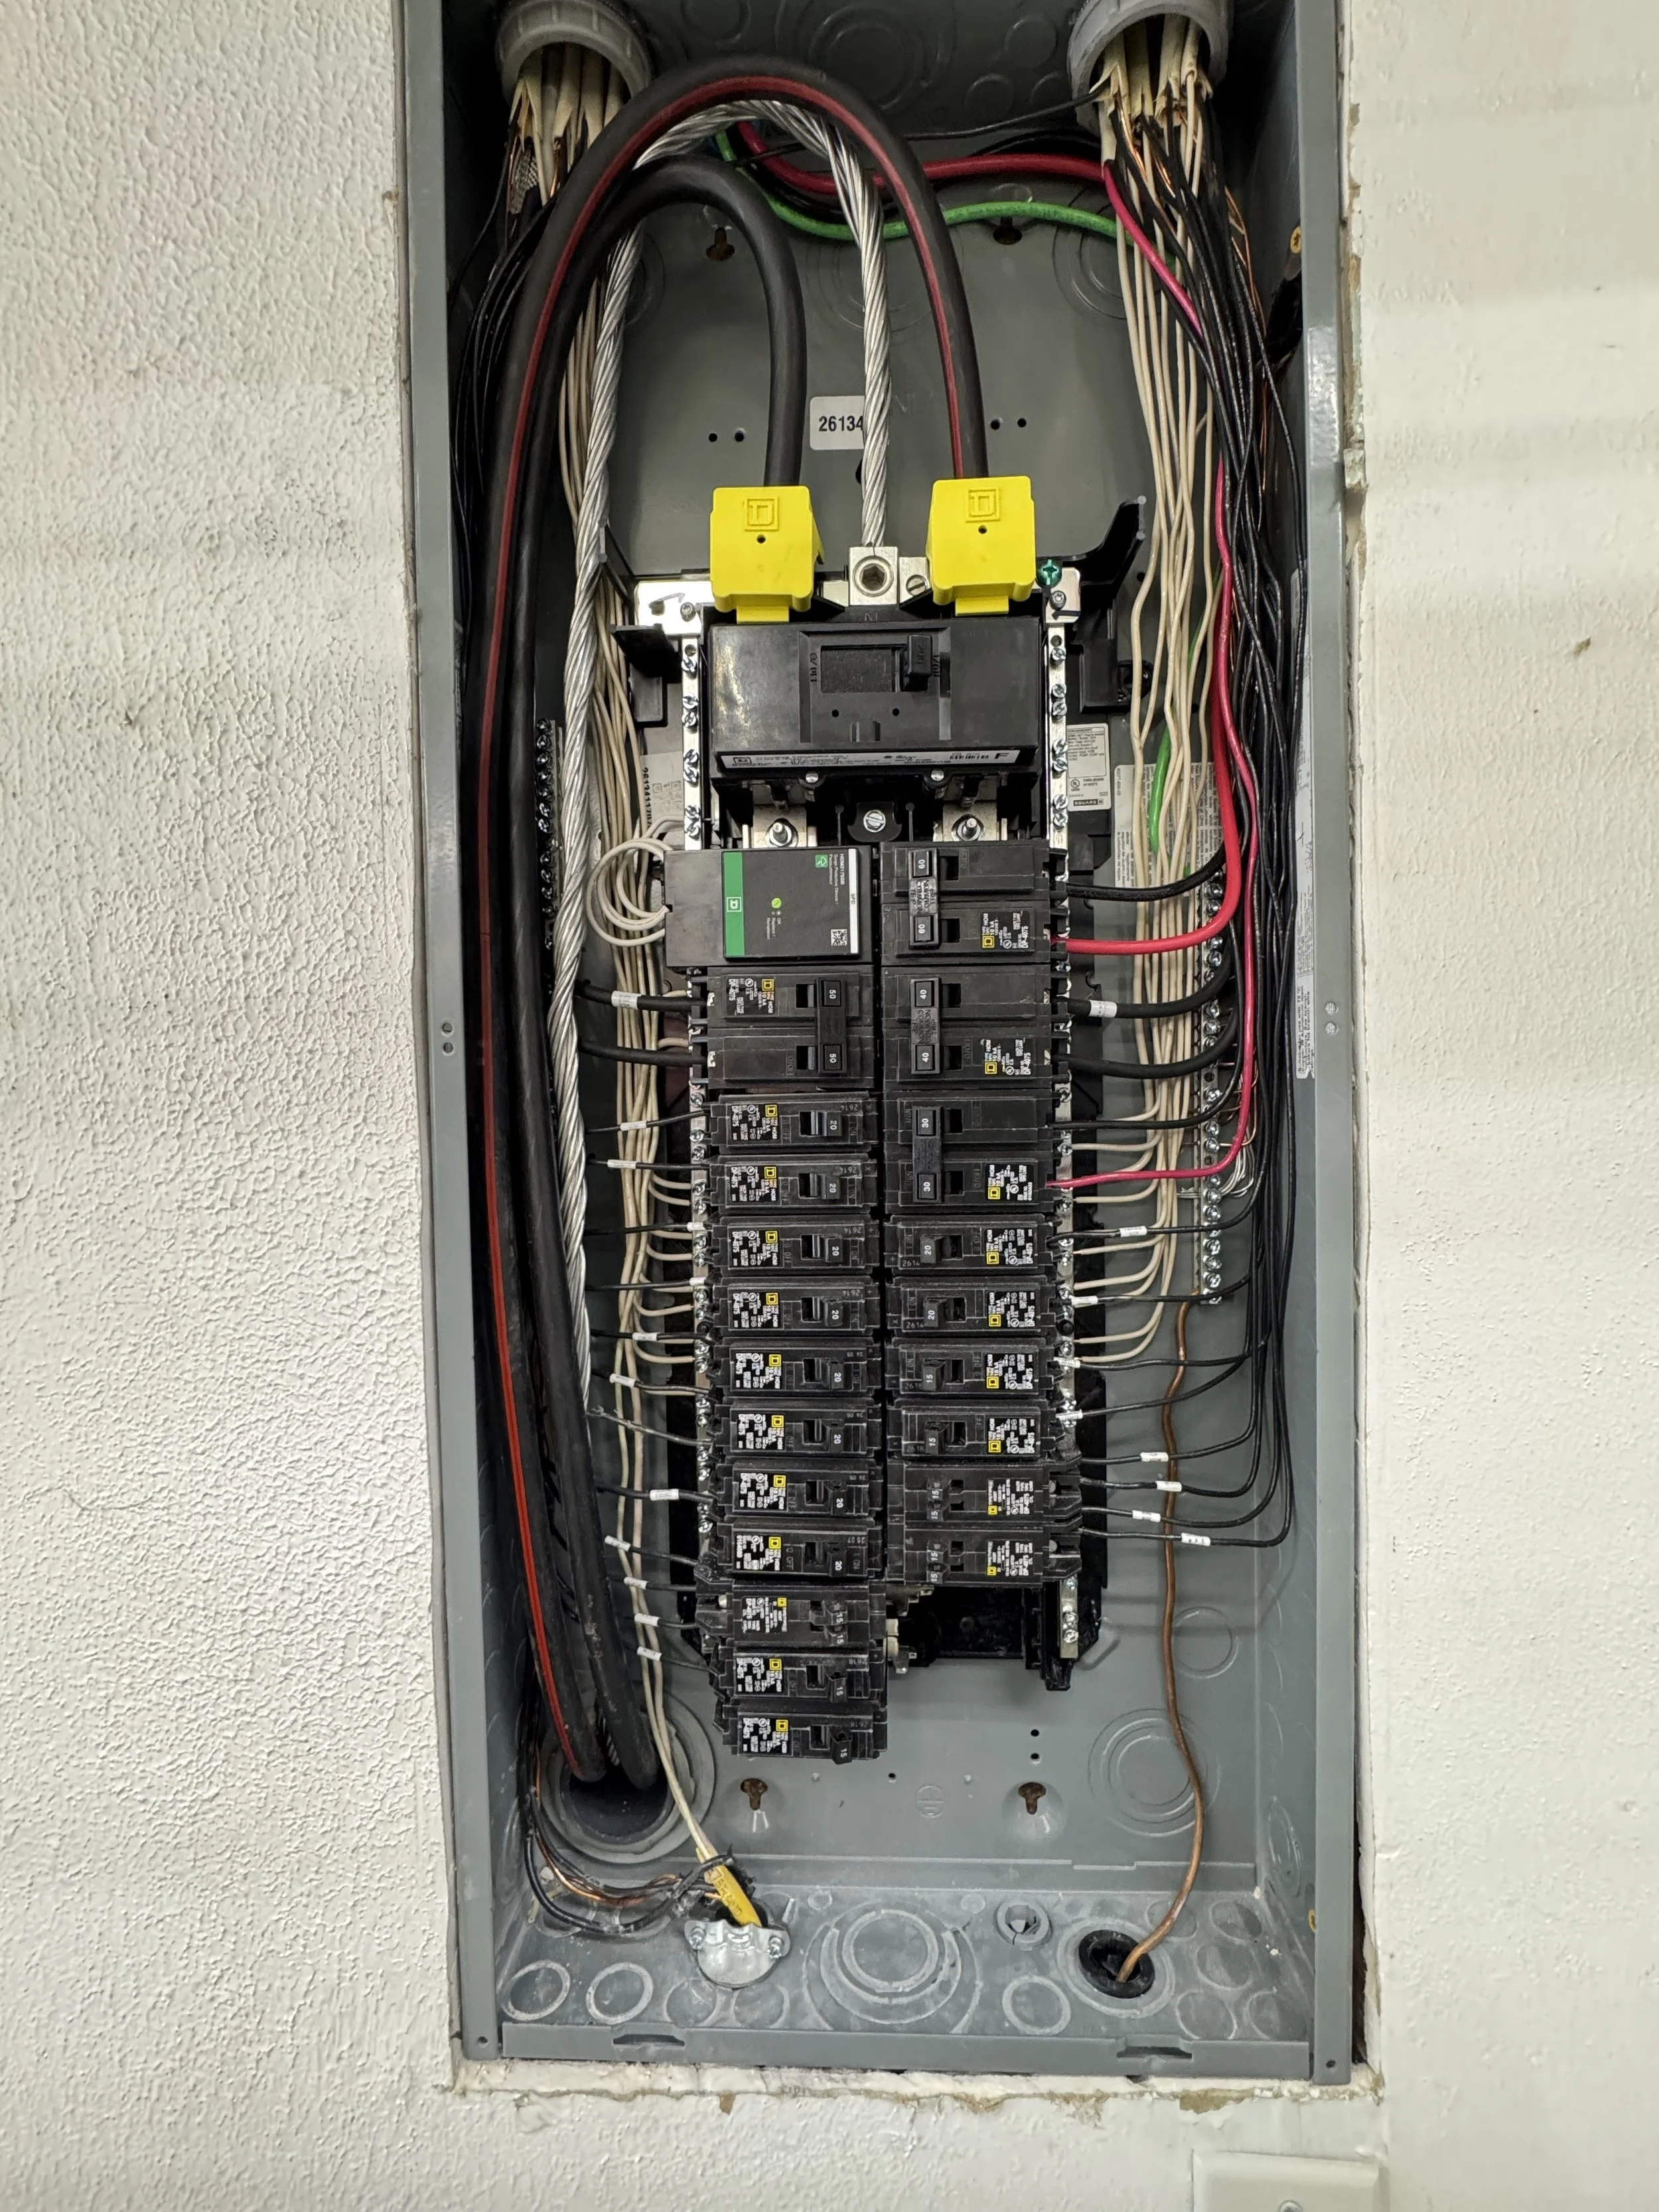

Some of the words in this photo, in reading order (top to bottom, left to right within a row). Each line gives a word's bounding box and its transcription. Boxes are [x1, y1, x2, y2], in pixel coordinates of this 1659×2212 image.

[818, 415, 863, 432] 26134
[918, 859, 925, 869] 60
[918, 924, 925, 934] 60
[829, 990, 836, 999] 50
[920, 990, 927, 999] 40
[830, 1053, 837, 1063] 50
[922, 1052, 929, 1063] 40
[830, 1120, 837, 1131] 20
[921, 1118, 929, 1128] 30
[829, 1183, 837, 1194] 20
[923, 1181, 931, 1192] 30
[831, 1246, 839, 1256] 20
[924, 1245, 932, 1255] 20
[831, 1309, 839, 1320] 20
[927, 1310, 935, 1320] 20
[834, 1372, 841, 1382] 20
[926, 1374, 934, 1384] 15
[833, 1434, 841, 1444] 20
[928, 1438, 936, 1447] 15
[932, 1490, 940, 1499] 15
[836, 1497, 843, 1509] 20
[930, 1511, 938, 1519] 15
[930, 1552, 938, 1561] 15
[835, 1560, 843, 1571] 20
[930, 1573, 938, 1582] 15
[836, 1612, 843, 1623] 15
[837, 1635, 844, 1645] 15
[836, 1686, 843, 1696] 15
[840, 1748, 847, 1758] 15
